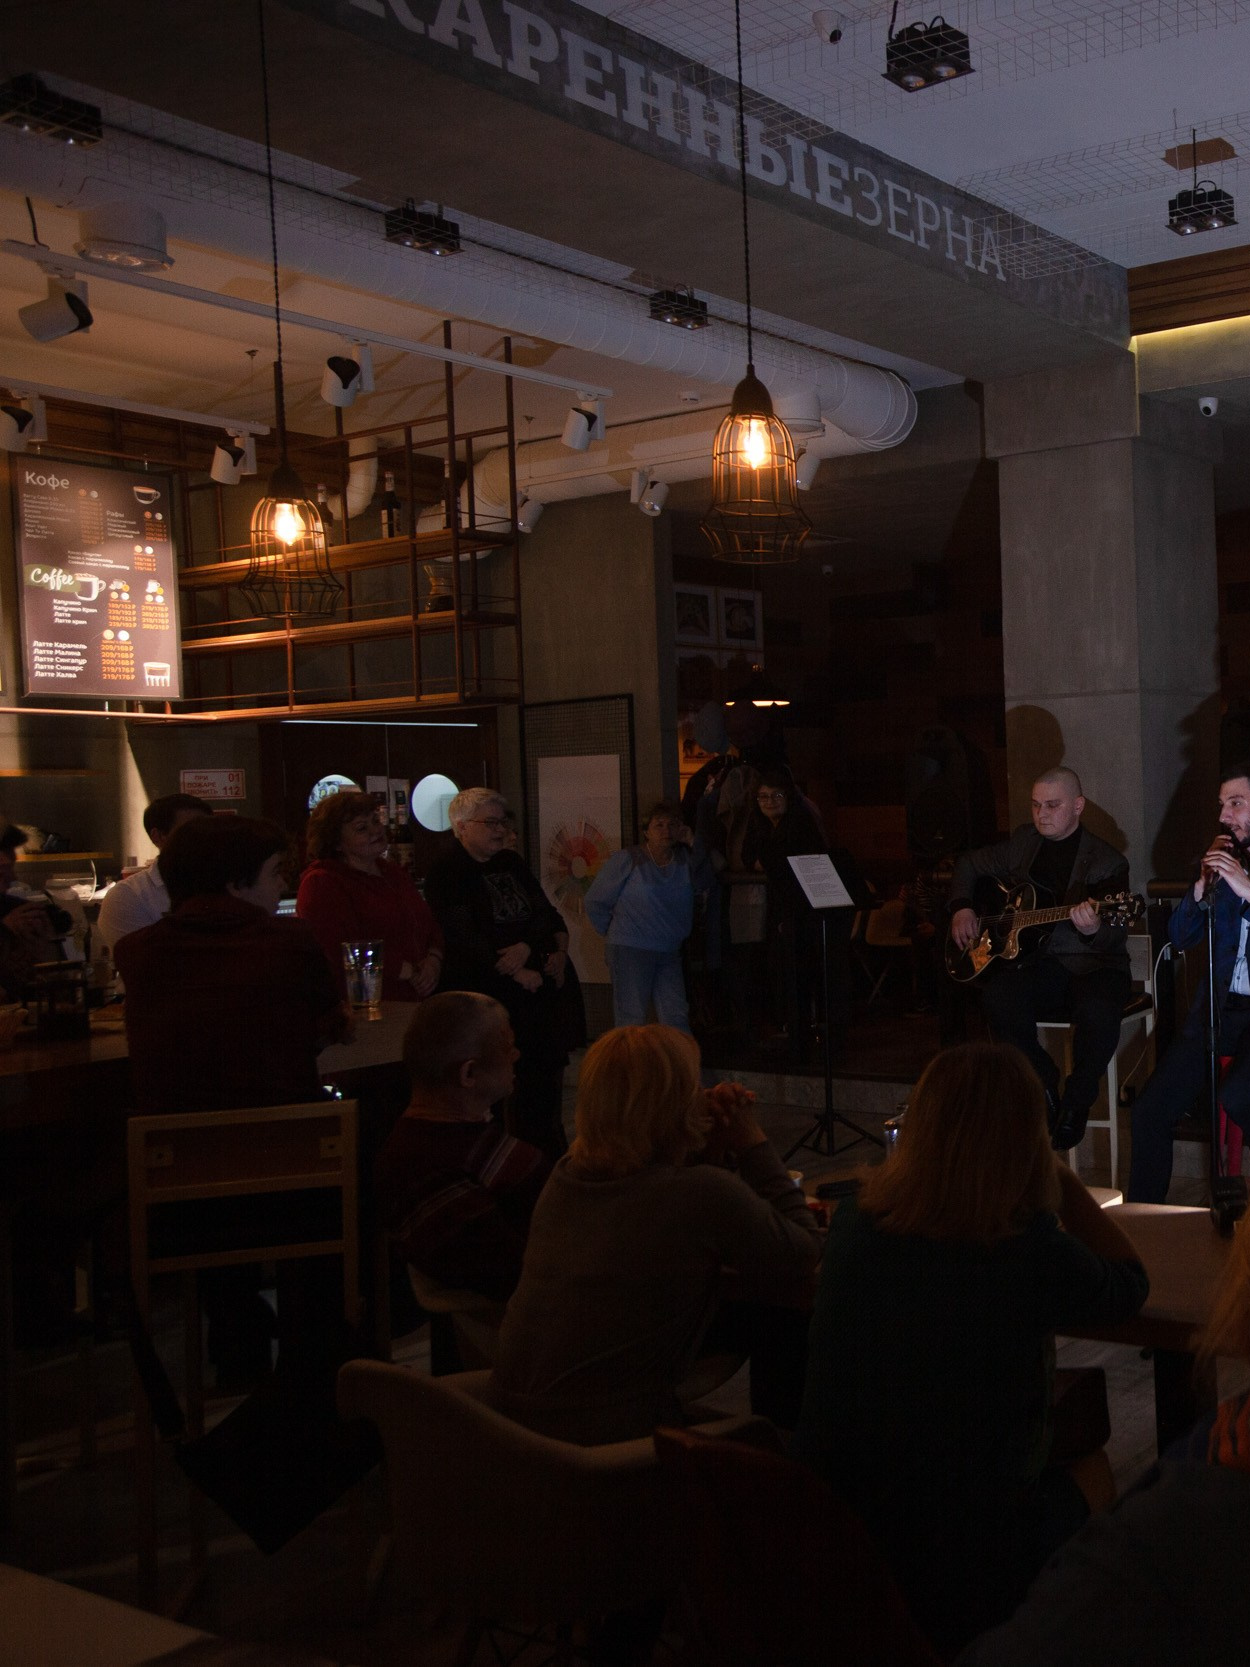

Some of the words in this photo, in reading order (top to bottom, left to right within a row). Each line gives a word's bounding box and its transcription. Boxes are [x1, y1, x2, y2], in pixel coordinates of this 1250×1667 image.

[25, 471, 70, 490] Кофе
[31, 568, 74, 591] Coffee
[55, 657, 88, 665] Сингапур
[55, 664, 84, 672] Сникерс
[228, 773, 240, 782] 01
[223, 786, 241, 795] 112
